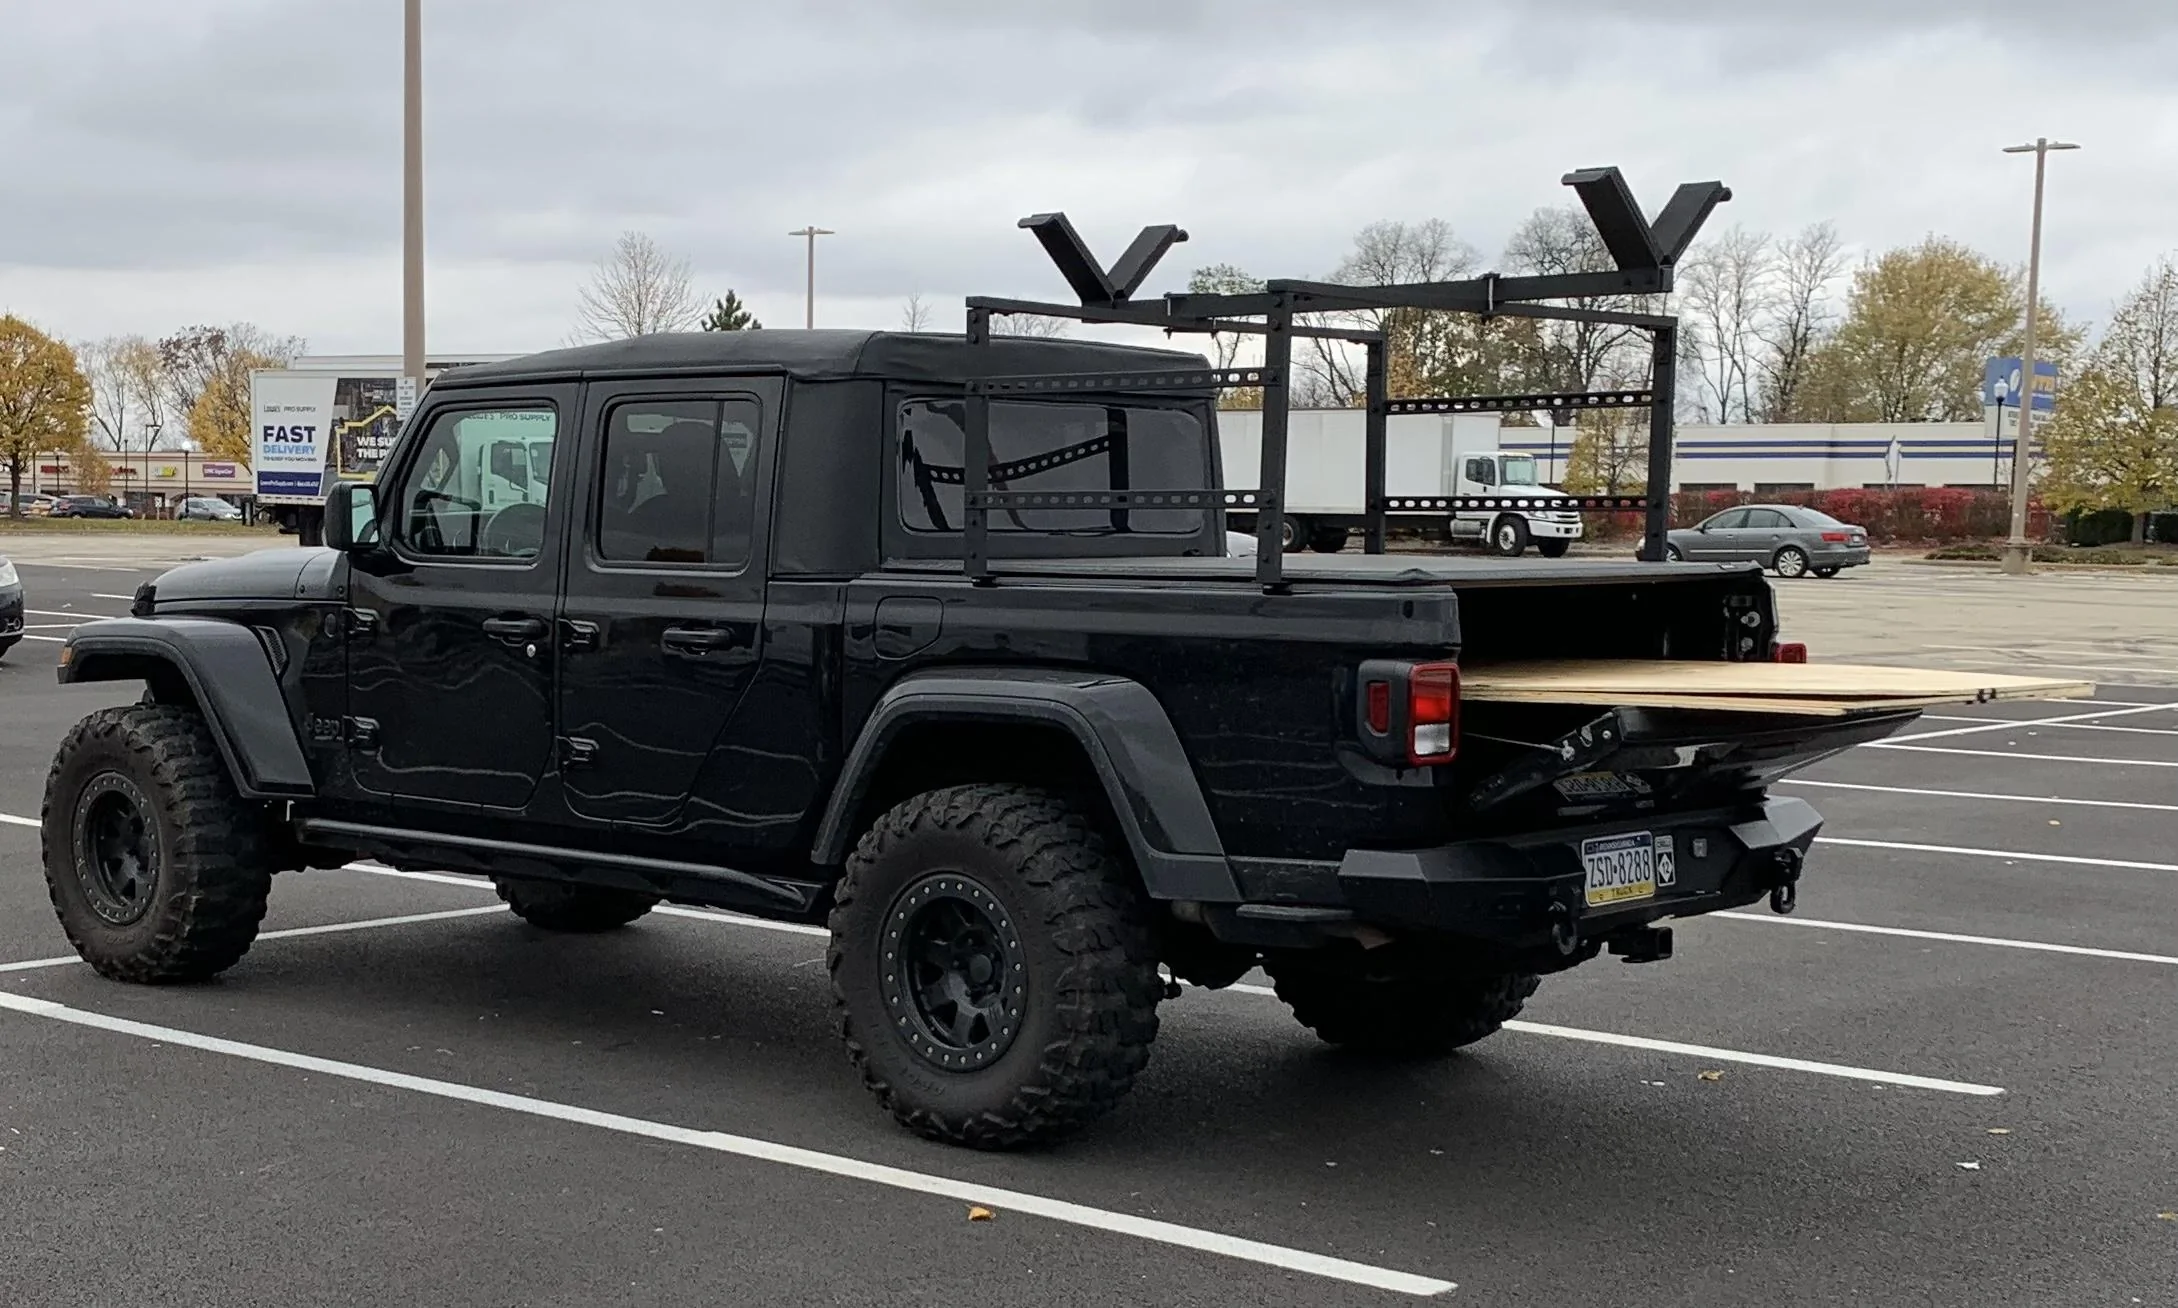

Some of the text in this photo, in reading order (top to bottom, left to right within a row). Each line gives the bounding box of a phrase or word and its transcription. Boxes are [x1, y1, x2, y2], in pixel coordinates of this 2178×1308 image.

[263, 425, 316, 443] FAST
[357, 437, 396, 446] WE SU
[263, 445, 316, 455] DELIVERY
[357, 448, 378, 459] THE
[1662, 860, 1670, 874] 12
